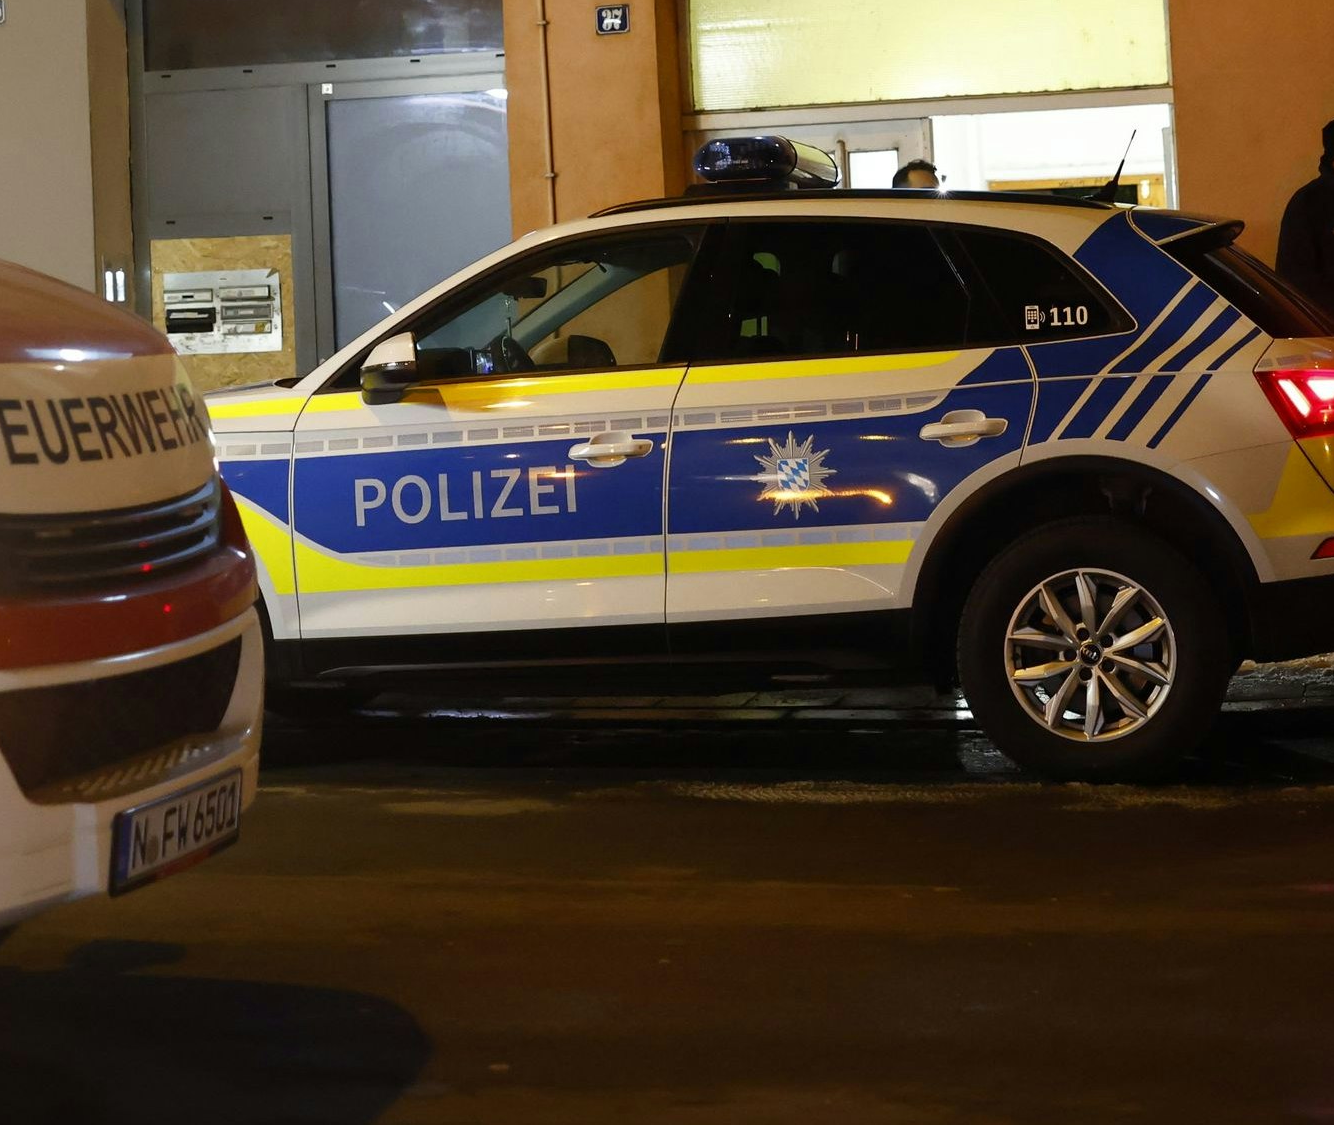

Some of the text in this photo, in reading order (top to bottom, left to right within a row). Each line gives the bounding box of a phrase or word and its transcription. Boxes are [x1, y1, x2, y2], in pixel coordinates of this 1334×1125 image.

[1049, 306, 1089, 327] 110
[354, 464, 577, 528] POLIZEI
[132, 782, 237, 869] N FW 6501
